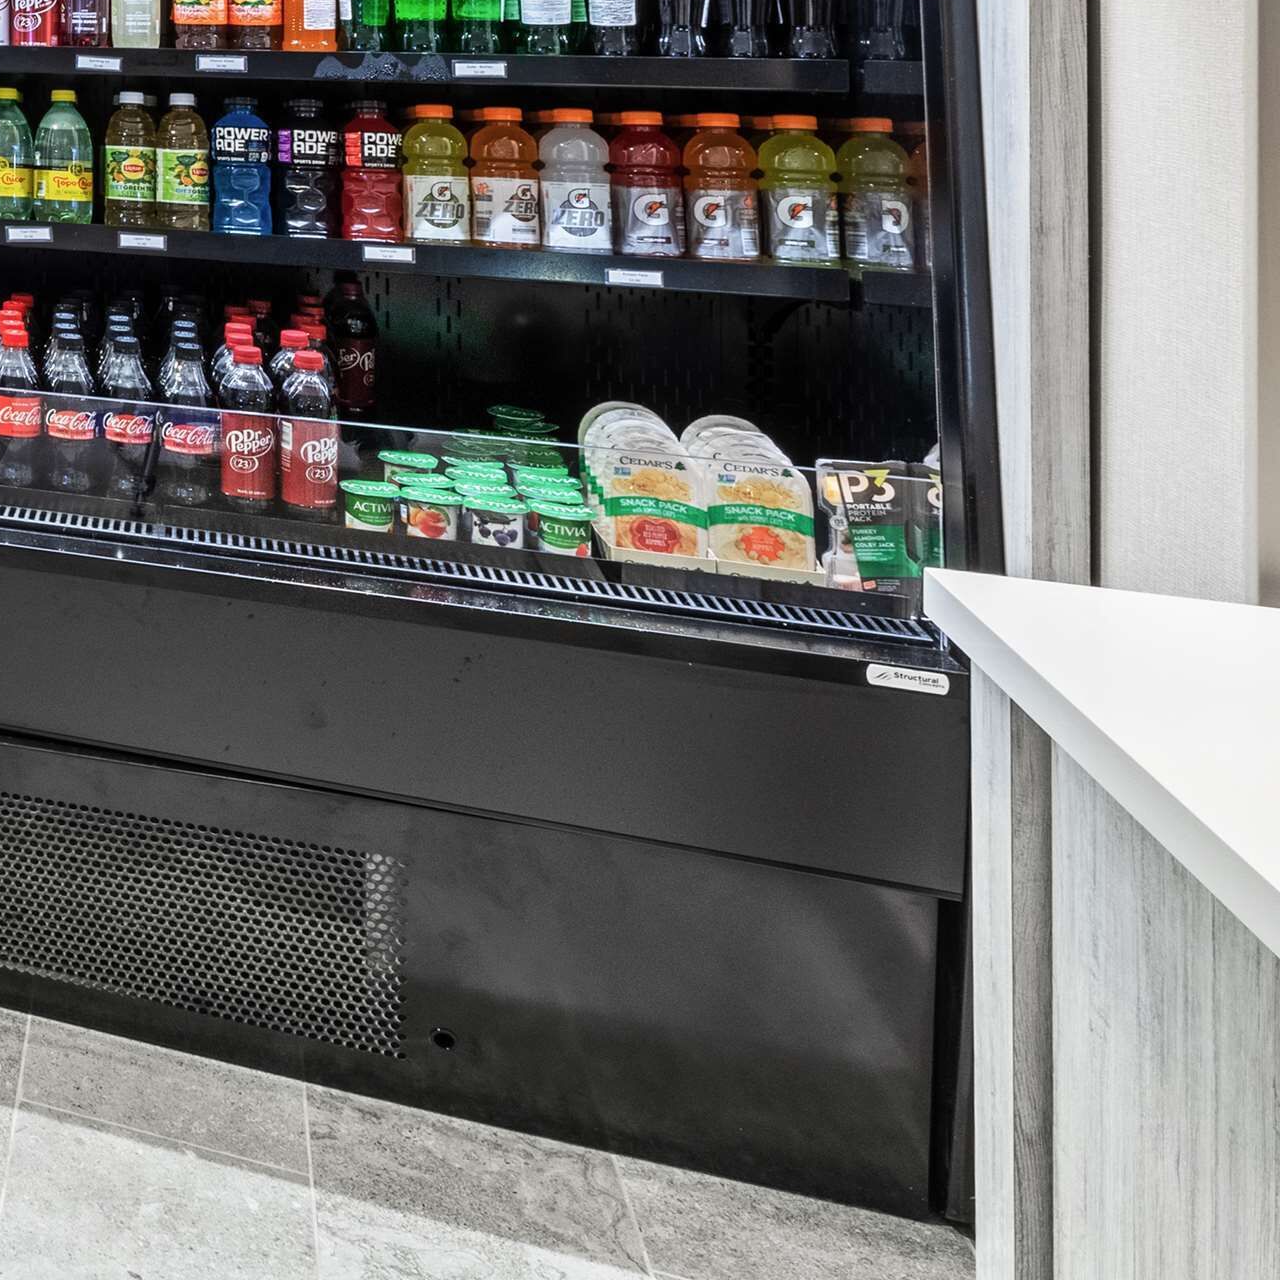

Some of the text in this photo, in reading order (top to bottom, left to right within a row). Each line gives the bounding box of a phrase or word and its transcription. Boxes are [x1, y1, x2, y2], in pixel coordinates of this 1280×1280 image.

[216, 127, 268, 141] POWER
[293, 130, 337, 144] POWE
[293, 142, 327, 155] ADE
[364, 145, 396, 158] ADE
[1, 171, 26, 185] Chico
[53, 177, 78, 187] Topo
[430, 182, 452, 201] G
[568, 188, 591, 208] G
[415, 201, 465, 220] ZERO
[553, 208, 605, 227] ZERO
[633, 194, 670, 226] G
[694, 196, 728, 228] G
[777, 196, 813, 229] G
[46, 408, 96, 431] Coca-Cola
[103, 411, 153, 434] Coca-Cola
[162, 421, 213, 445] Coca-Cola
[244, 429, 263, 441] Dr
[230, 431, 271, 455] Pepper
[619, 456, 673, 469] CEDAR'S
[723, 463, 779, 476] CEDAR'S
[620, 498, 688, 514] SNACK PACK
[724, 506, 796, 522] SNACK PACK
[540, 520, 586, 538] ACTIVIA
[893, 671, 940, 684] Structural
